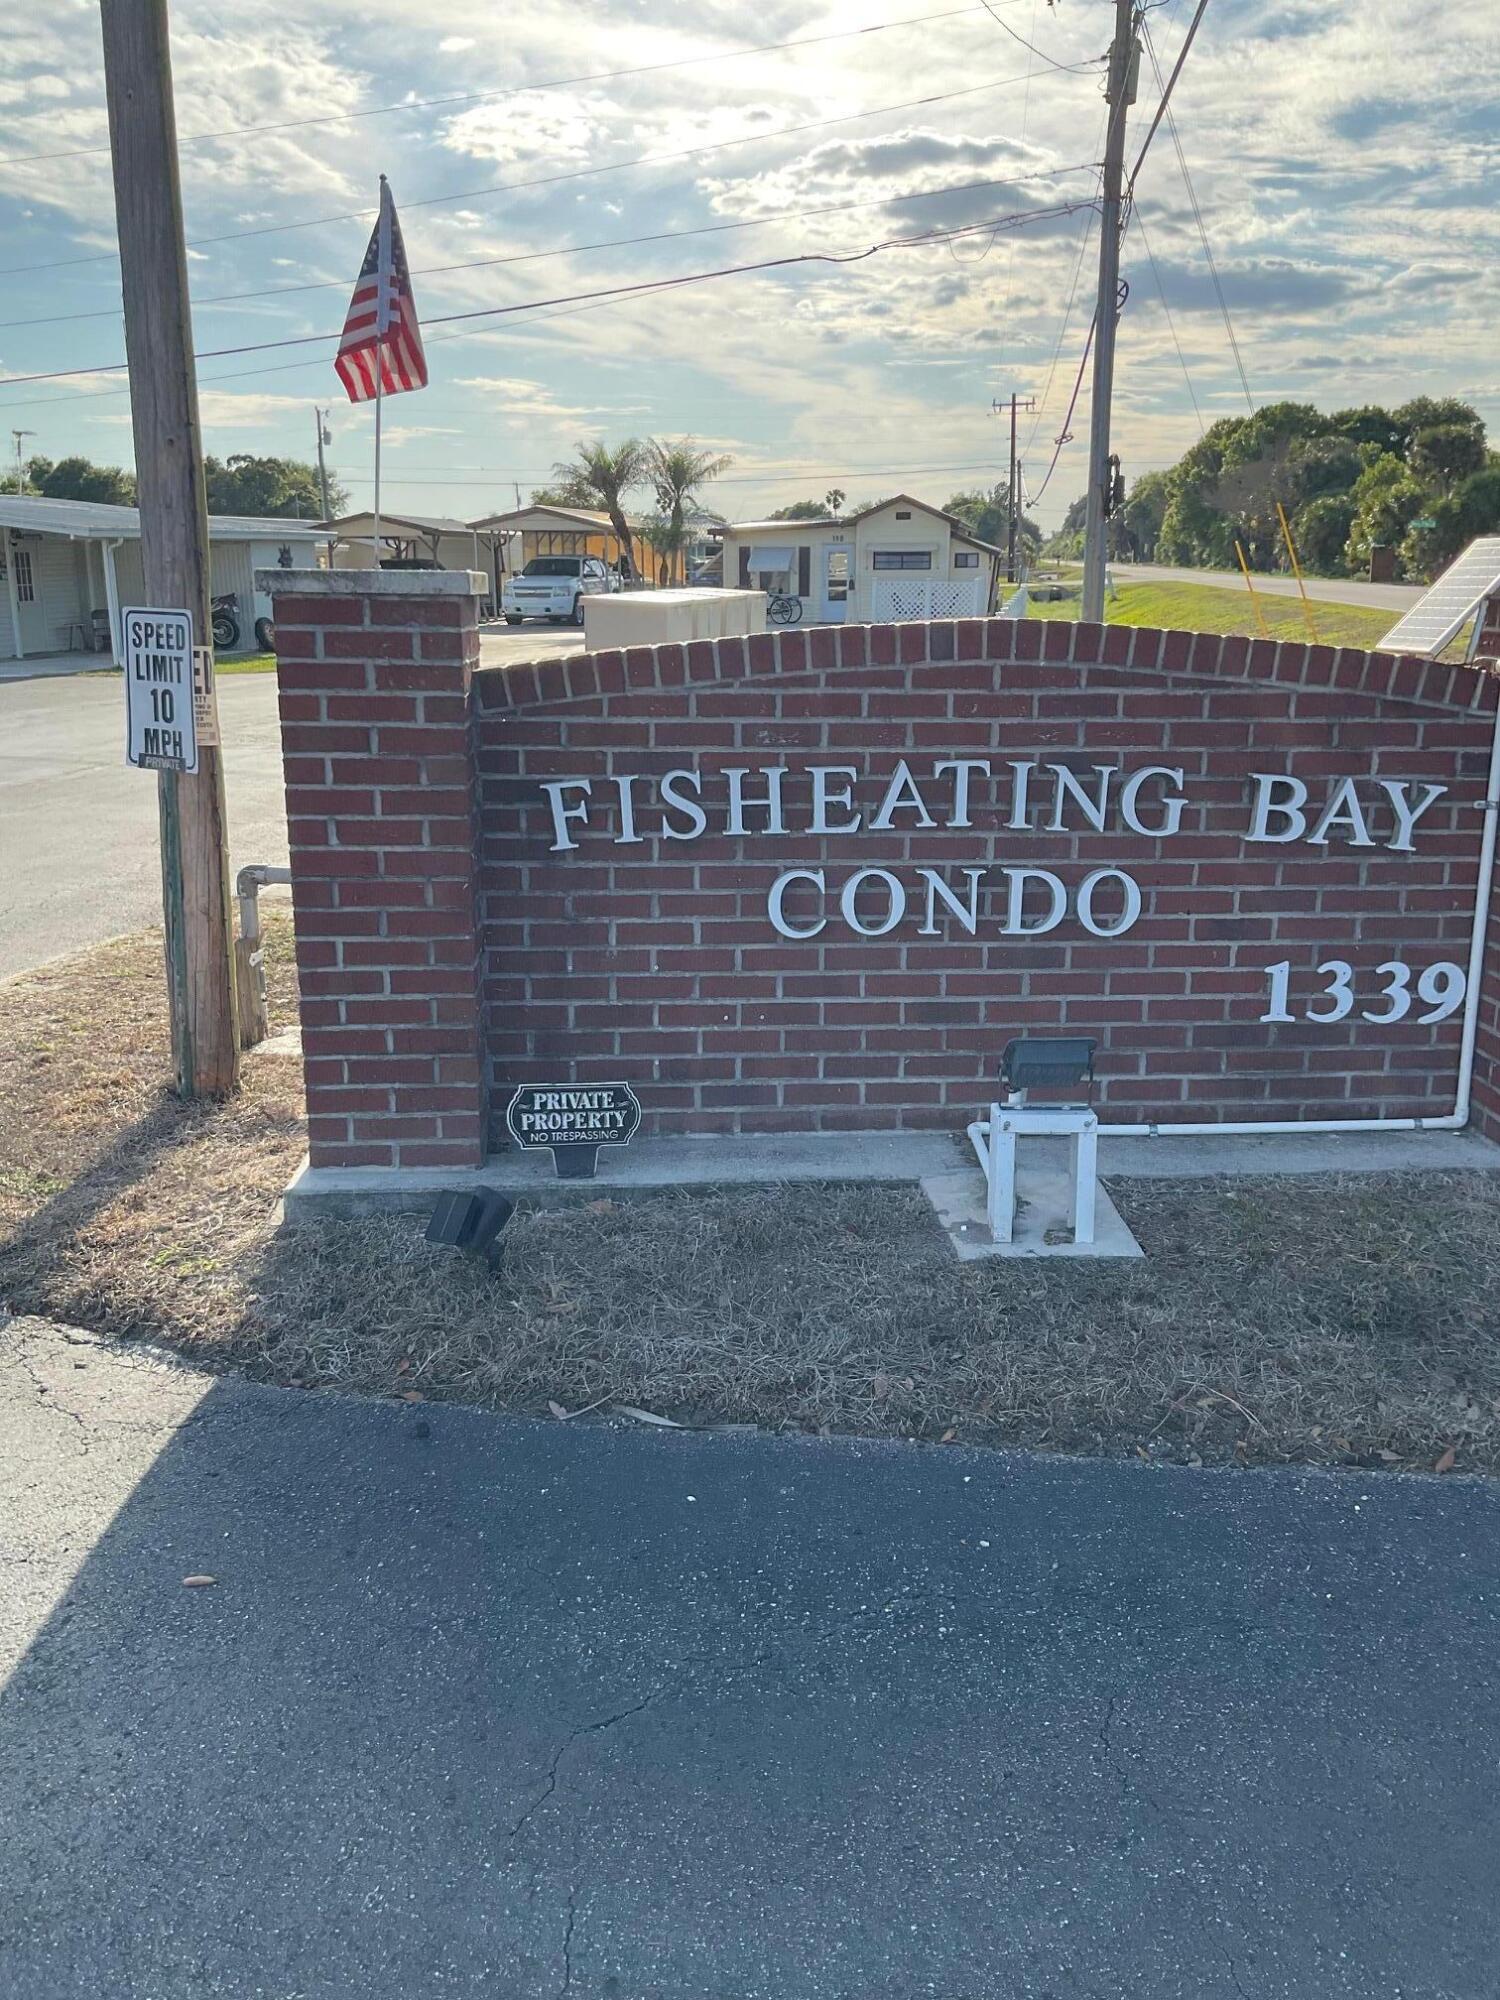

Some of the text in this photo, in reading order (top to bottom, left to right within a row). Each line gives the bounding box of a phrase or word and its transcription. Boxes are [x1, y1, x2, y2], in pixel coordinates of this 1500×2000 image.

[132, 621, 186, 650] SPEED
[135, 653, 184, 684] LIMIT
[150, 688, 175, 724] 10
[144, 727, 183, 757] MPH
[539, 758, 1449, 851] FISHEATING BAY
[767, 868, 1142, 939] CONDO
[1259, 960, 1467, 1025] 1339
[533, 1090, 615, 1110] PRIVATE
[520, 1110, 628, 1131] PROPERTY
[530, 1129, 619, 1142] NO TRESPASSING
